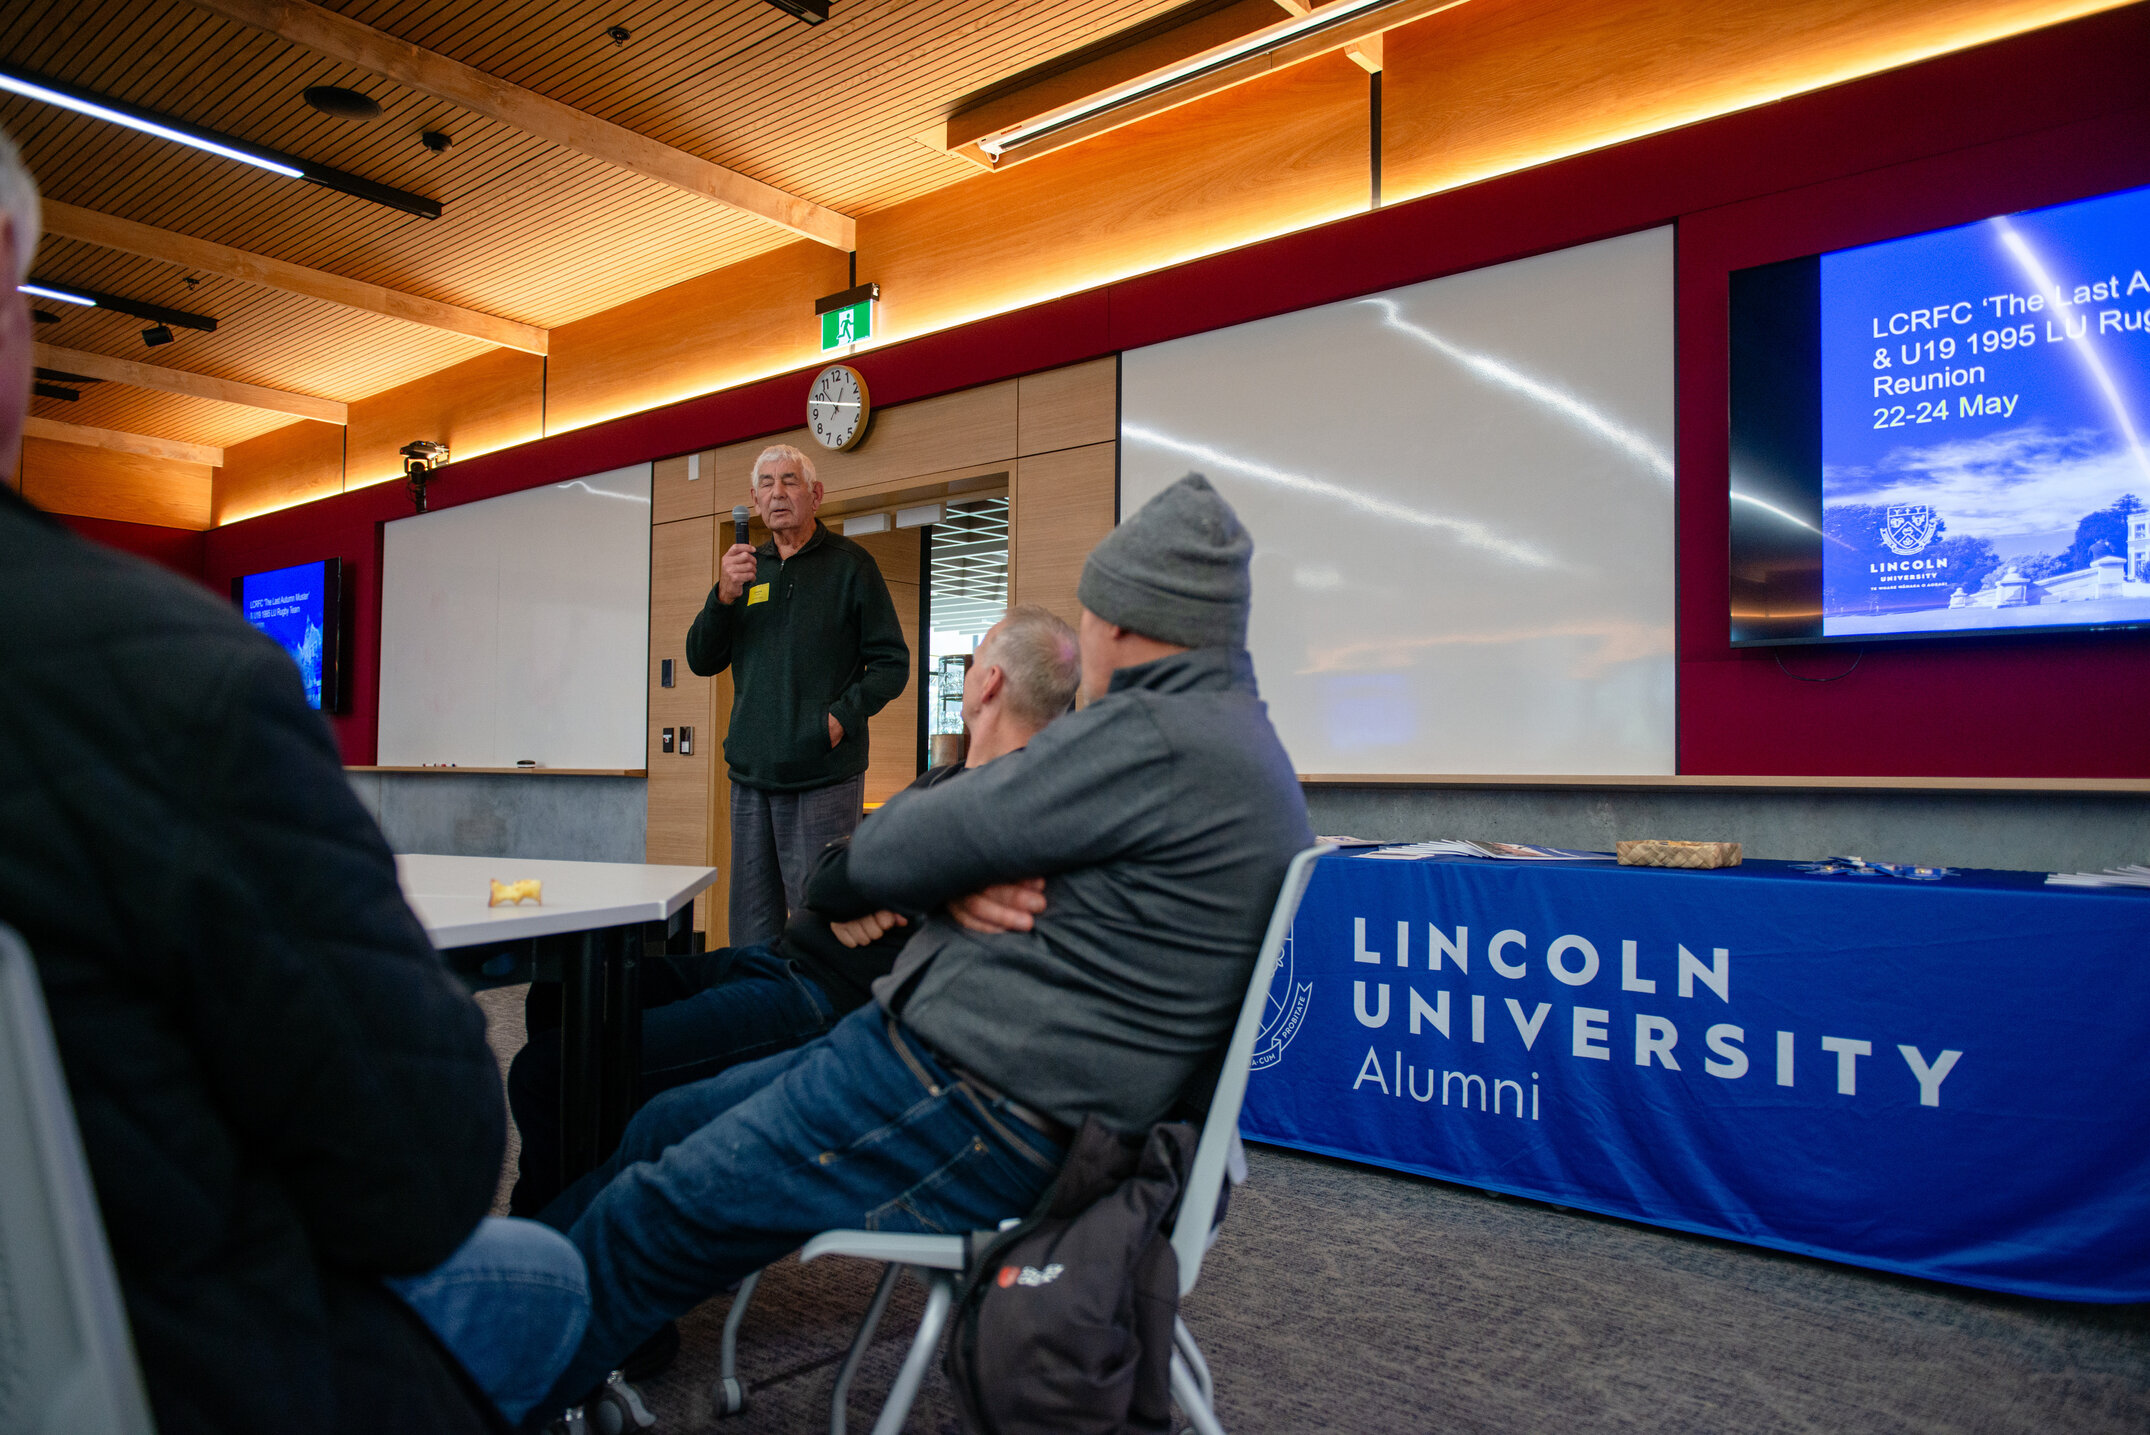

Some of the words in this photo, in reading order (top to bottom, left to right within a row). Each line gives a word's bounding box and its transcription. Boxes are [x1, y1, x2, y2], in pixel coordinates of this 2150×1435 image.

[1873, 302, 1973, 339] LCRFC
[2055, 274, 2120, 308] Last
[1872, 347, 1893, 370] &
[1901, 336, 1956, 365] U19
[1966, 324, 2037, 354] 1995
[2046, 314, 2087, 343] LU
[831, 369, 841, 382] 12
[845, 372, 850, 384] 1
[1873, 366, 1986, 398] Reunion
[821, 378, 830, 391] 11
[852, 382, 859, 394] 2
[814, 392, 825, 406] 10
[813, 408, 819, 420] 9
[1873, 399, 1950, 430] 22-24
[1959, 394, 2019, 419] May
[817, 423, 823, 434] 8
[847, 427, 853, 440] 5
[826, 432, 832, 445] 7
[836, 434, 842, 446] 6
[1870, 558, 1948, 574] LINCOLN
[1880, 572, 1938, 583] UNIVERSITY
[1354, 917, 1729, 1004] LINCOLN
[1281, 995, 1306, 1039] PROBITATE
[1353, 980, 1963, 1107] UNIVERSITY
[1352, 1045, 1539, 1121] Alumni
